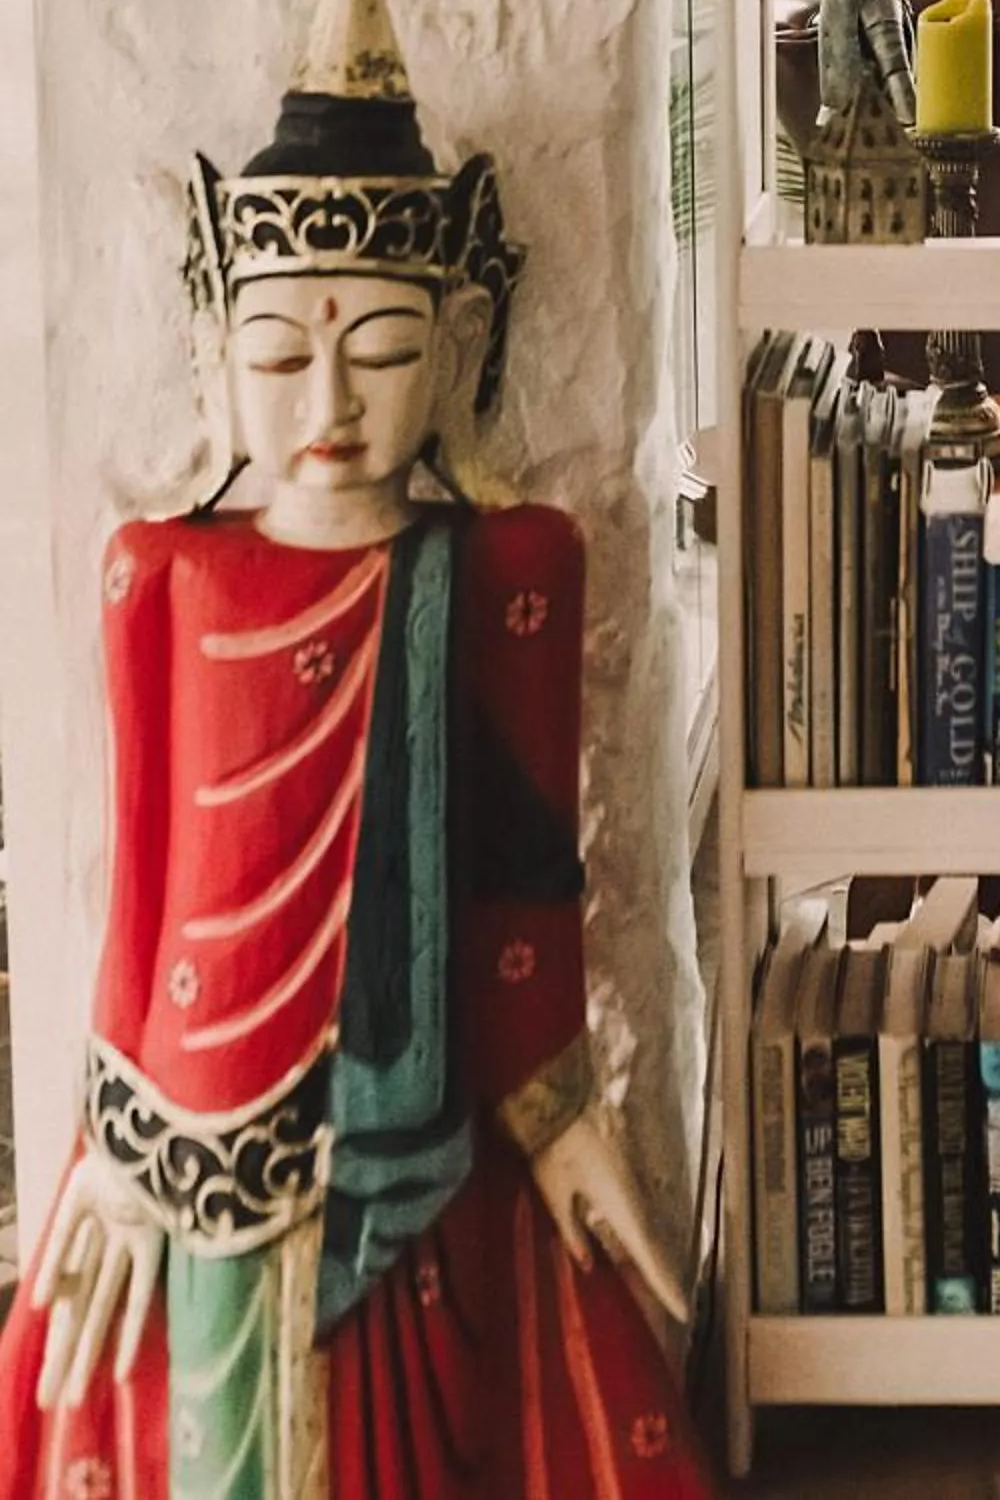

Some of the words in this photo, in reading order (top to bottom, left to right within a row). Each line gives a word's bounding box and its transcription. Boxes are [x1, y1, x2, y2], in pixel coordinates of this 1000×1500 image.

[950, 529, 978, 622] SHIP
[949, 654, 976, 766] GOLD
[805, 1127, 833, 1154] UP
[808, 1155, 834, 1205] BEN
[807, 1210, 834, 1284] FOGLE
